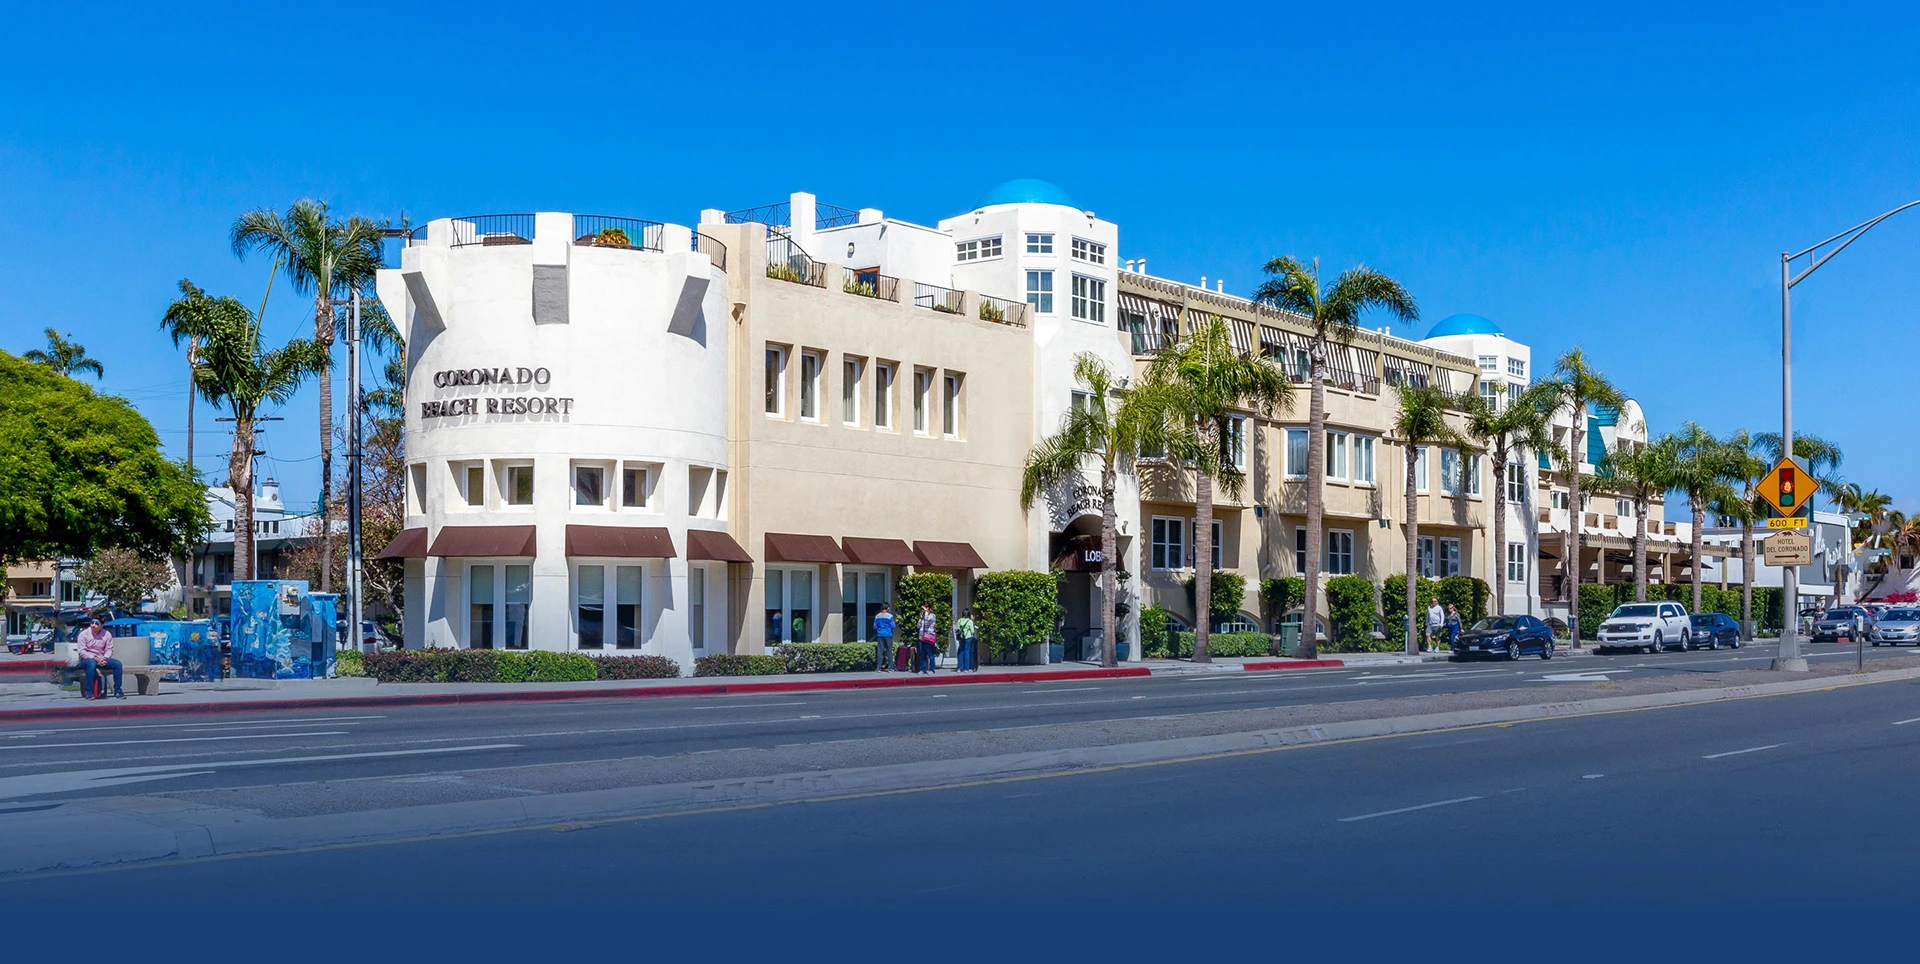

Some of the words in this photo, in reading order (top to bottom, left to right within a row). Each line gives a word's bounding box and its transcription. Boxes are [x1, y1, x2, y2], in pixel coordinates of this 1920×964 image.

[434, 367, 551, 388] CORONADO
[421, 398, 479, 419] BEACH
[486, 397, 574, 415] RESORT
[1073, 485, 1106, 500] CORONA
[1067, 499, 1090, 518] BEACH
[1770, 519, 1787, 527] 600
[1085, 550, 1102, 562] LOB
